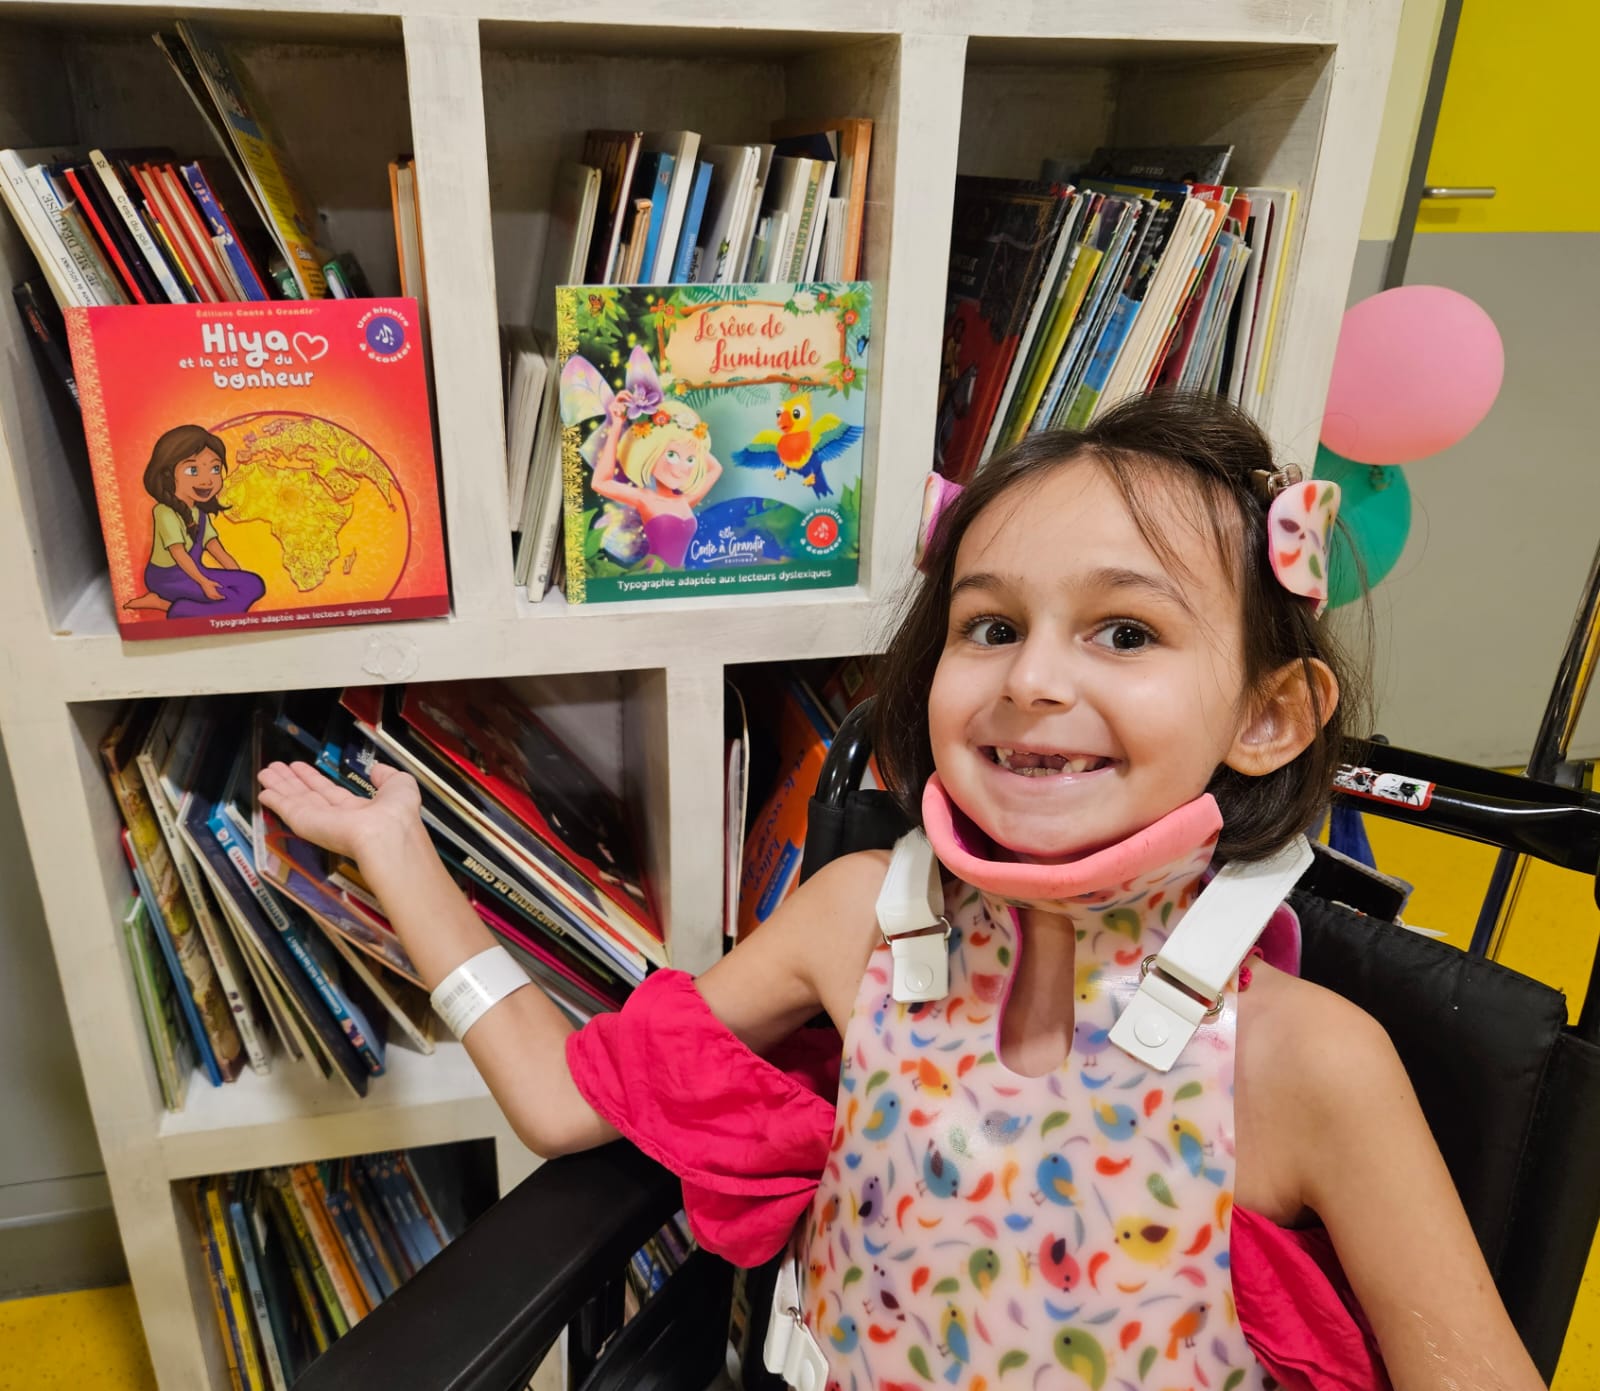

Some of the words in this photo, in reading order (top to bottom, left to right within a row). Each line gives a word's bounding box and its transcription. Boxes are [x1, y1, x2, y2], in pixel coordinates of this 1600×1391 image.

[131, 218, 141, 232] du
[73, 250, 93, 271] ME
[357, 312, 372, 328] Une
[372, 306, 409, 327] histoire
[694, 312, 718, 342] Le
[720, 315, 757, 337] rêve
[760, 313, 786, 338] de
[201, 322, 289, 368] Hiya
[178, 357, 195, 369] et
[199, 357, 214, 368] la
[218, 353, 239, 368] clé
[274, 353, 293, 365] du
[709, 338, 821, 375] Luminaile
[213, 368, 314, 390] bonheur
[801, 511, 814, 527] Une
[814, 508, 844, 525] histoire
[691, 539, 718, 561] Conte
[719, 539, 726, 554] à
[728, 535, 766, 557] Grandir
[616, 578, 676, 592] Typographie
[678, 573, 717, 588] adaptée
[719, 575, 736, 584] aux
[738, 570, 777, 583] lecteurs
[778, 568, 832, 582] dyslexiques
[209, 616, 259, 628] Typographie
[261, 611, 294, 624] adaptée
[296, 613, 311, 621] aux
[312, 608, 345, 619] lecteurs
[346, 606, 392, 617] dyslexiques
[463, 856, 496, 883] CHINE
[493, 880, 510, 894] DE
